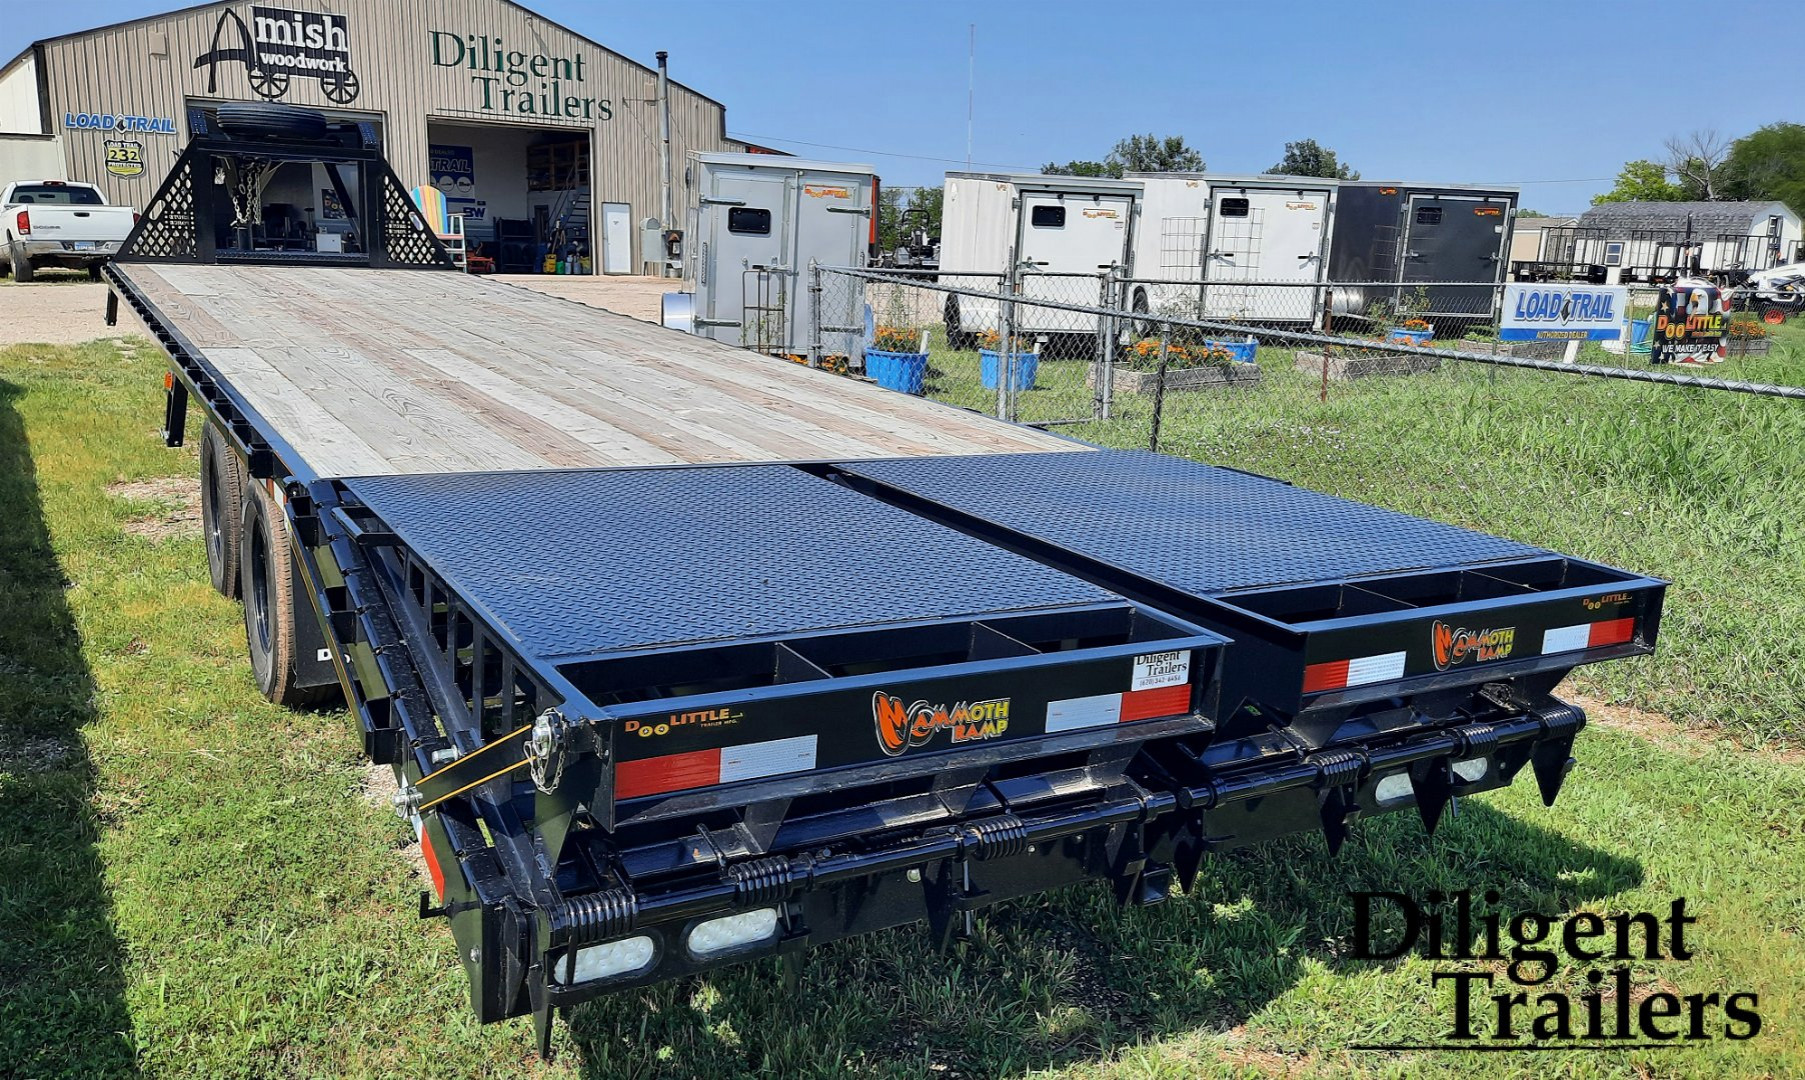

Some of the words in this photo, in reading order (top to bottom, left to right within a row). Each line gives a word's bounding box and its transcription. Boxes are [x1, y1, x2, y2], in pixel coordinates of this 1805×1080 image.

[260, 52, 347, 73] woodwork
[429, 30, 586, 87] Diligent
[471, 76, 613, 121] Trailers
[65, 113, 115, 129] LOAD
[125, 115, 176, 133] TRAIL
[109, 149, 138, 161] 232
[431, 157, 472, 173] TRAIL
[1515, 291, 1562, 319] LOAD
[1569, 292, 1614, 321] TRAIL
[1536, 331, 1568, 339] AUTHORIZED
[1569, 331, 1588, 339] DEALER
[1662, 344, 1674, 352] WE
[1674, 344, 1694, 352] MAKE
[1477, 643, 1514, 661] RAMP
[1146, 662, 1188, 676] Trailers
[952, 719, 1008, 743] RAMP
